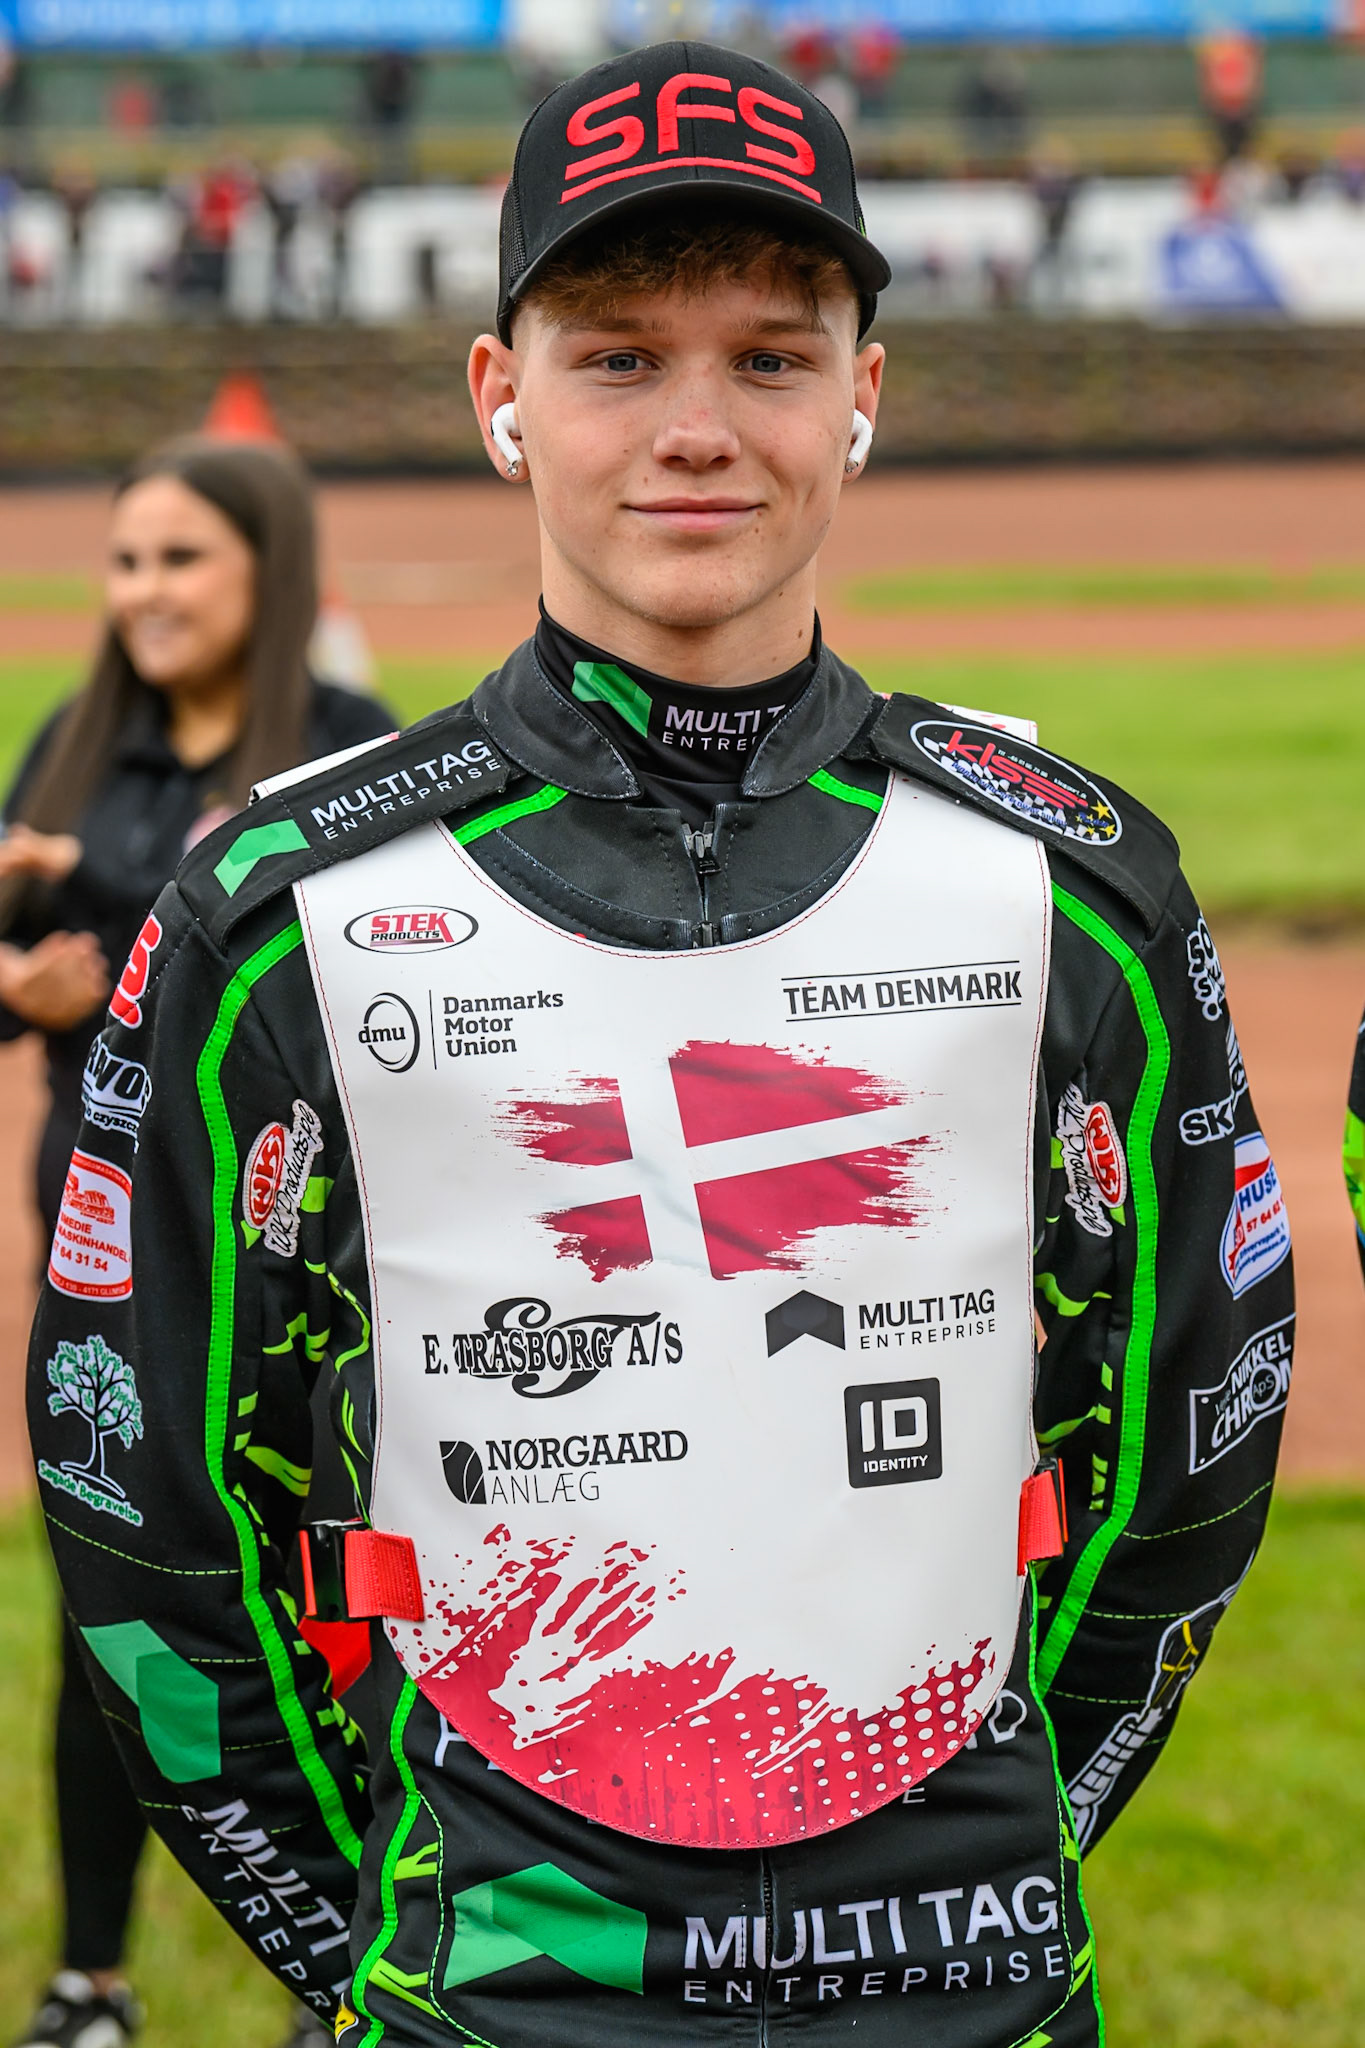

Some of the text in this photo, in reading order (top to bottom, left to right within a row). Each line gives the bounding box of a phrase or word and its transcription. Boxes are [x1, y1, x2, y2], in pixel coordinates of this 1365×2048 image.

[564, 72, 816, 181] SFS
[664, 704, 761, 735] MULTI
[310, 740, 492, 828] MULTI TAG
[323, 758, 501, 841] ENTREPRISE
[370, 930, 440, 942] PRODUCTS
[371, 912, 455, 943] STEK
[443, 990, 564, 1015] Danmarks
[783, 971, 1022, 1015] TEAM DENMARK
[358, 1025, 406, 1044] dmu
[444, 1016, 513, 1036] Motor
[446, 1037, 517, 1058] Union
[858, 1289, 995, 1330] MULTI TAG
[422, 1321, 684, 1375] E. TRASBORG A/S
[860, 1318, 996, 1350] ENTREPRISE
[1231, 1331, 1292, 1395] NIKKEL
[860, 1396, 929, 1453] ID
[485, 1430, 689, 1472] NØRGAARD
[863, 1454, 929, 1474] IDENTITY
[79, 1484, 141, 1524] Begravelse
[491, 1471, 600, 1505] ANLÆG
[684, 1876, 1059, 1971] MULTI TAG
[685, 1944, 1066, 2004] ENTREPRISE
